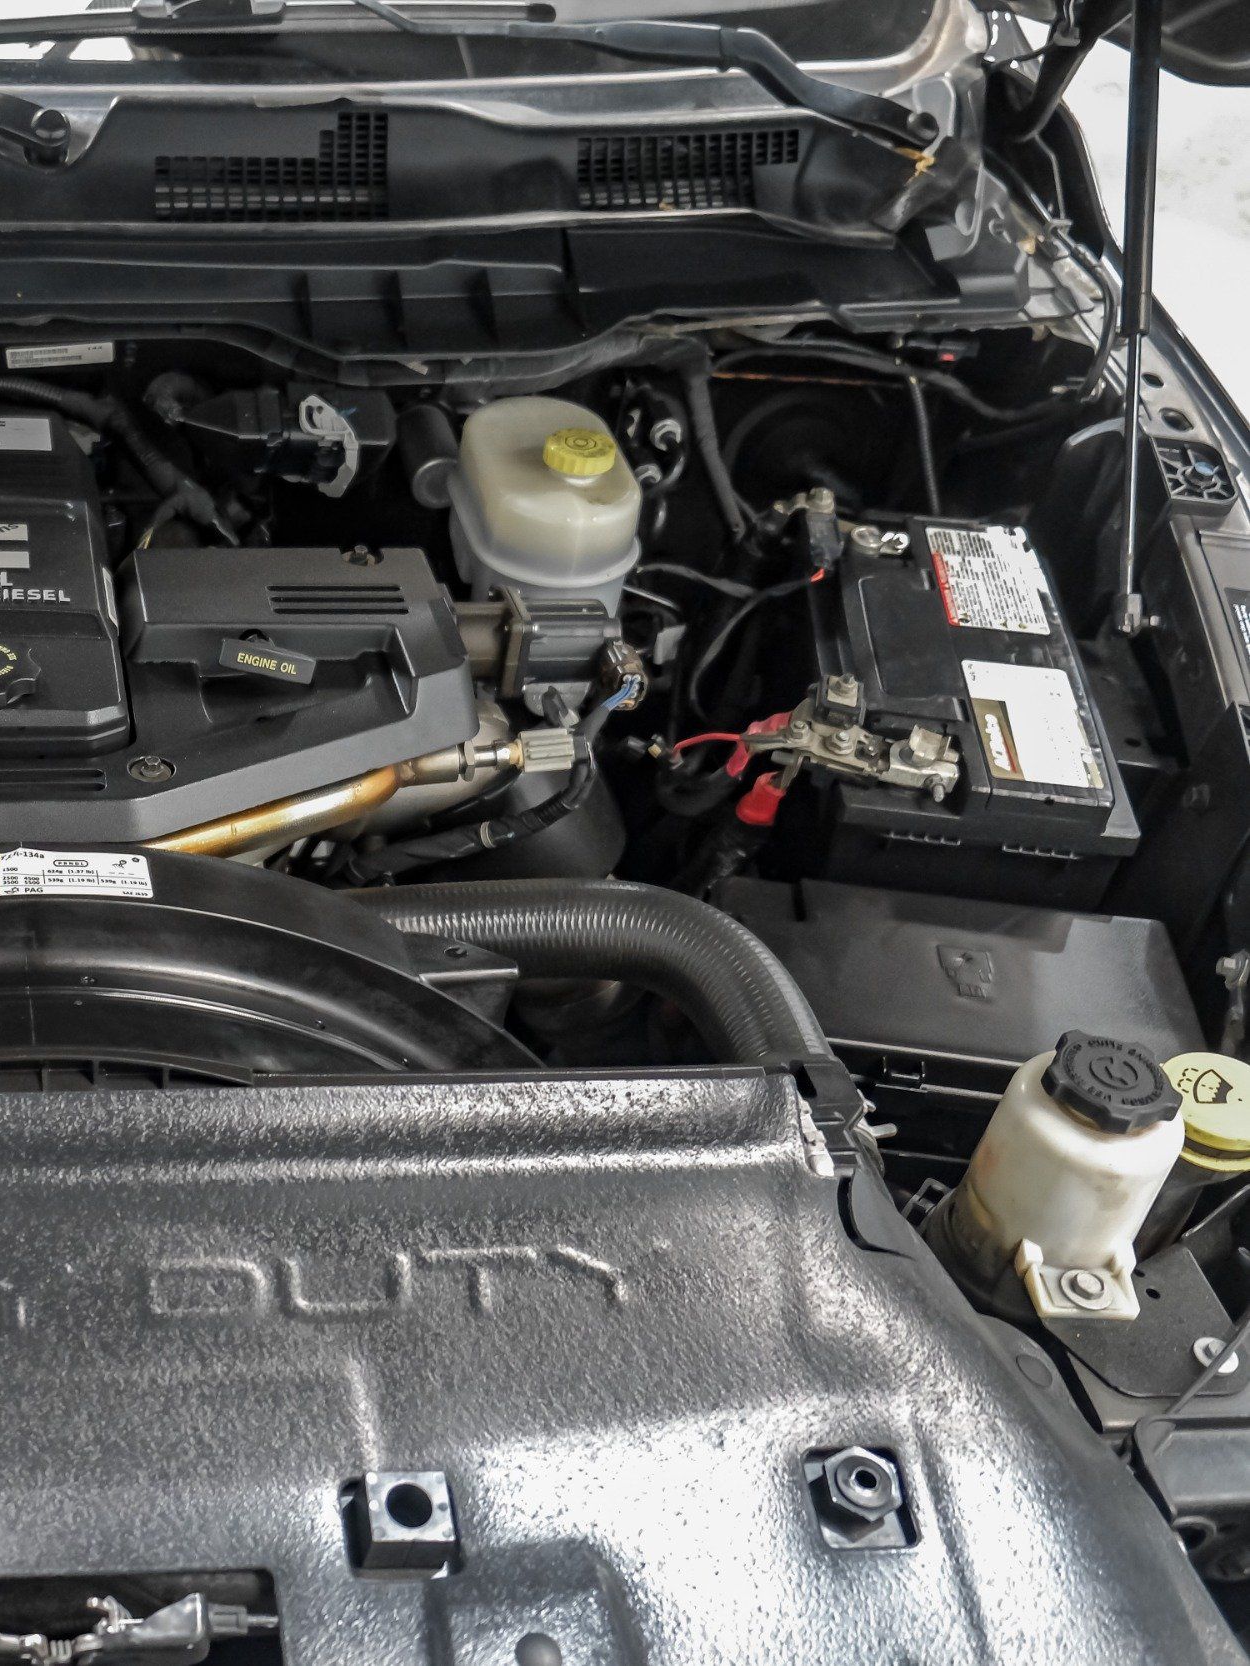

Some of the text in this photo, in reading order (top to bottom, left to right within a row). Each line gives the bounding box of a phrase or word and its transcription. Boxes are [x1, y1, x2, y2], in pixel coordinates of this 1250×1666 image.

[237, 652, 297, 675] ENGINE OIL
[140, 1243, 665, 1320] DUTY
